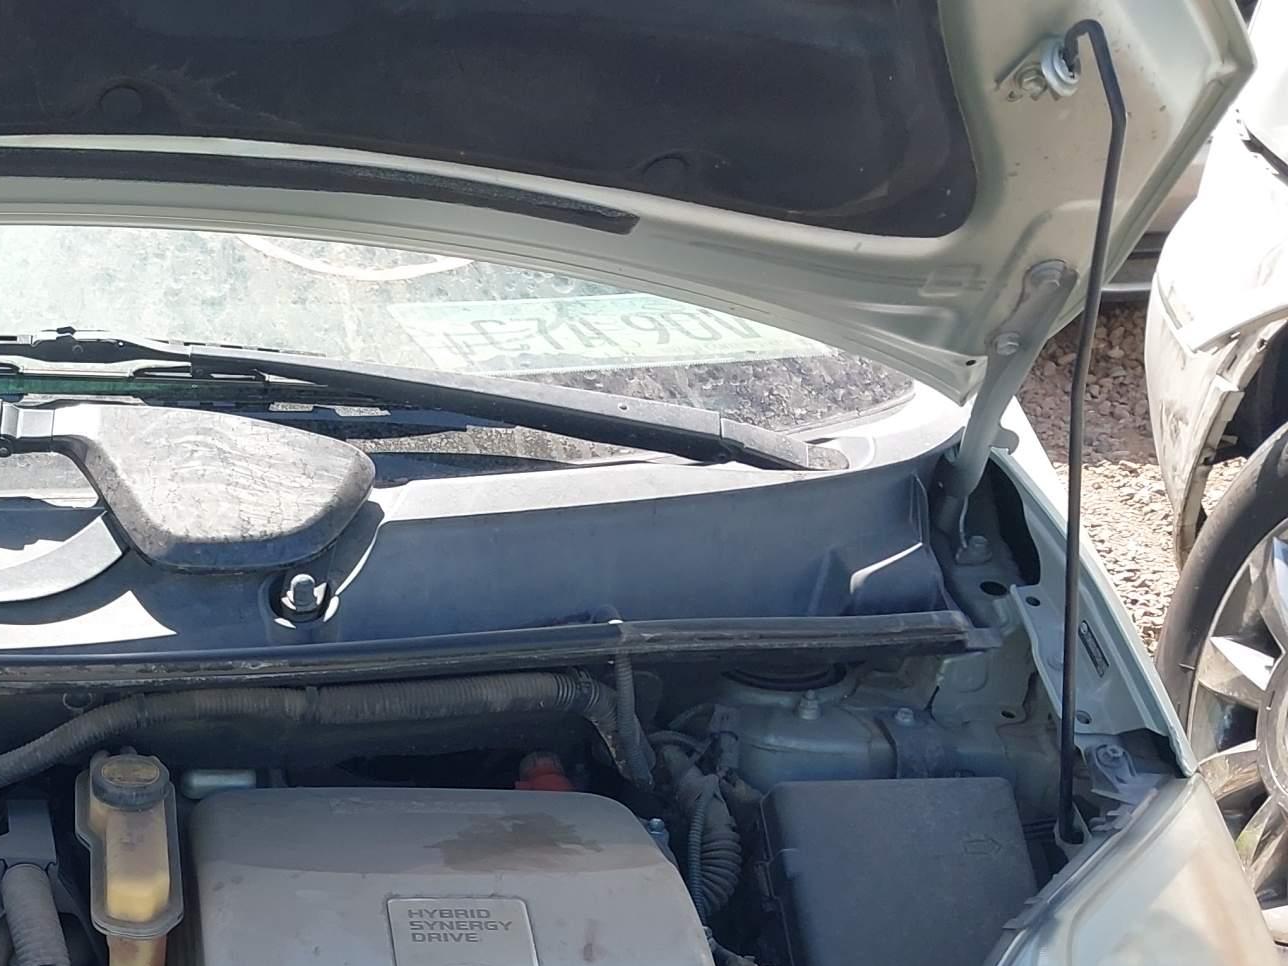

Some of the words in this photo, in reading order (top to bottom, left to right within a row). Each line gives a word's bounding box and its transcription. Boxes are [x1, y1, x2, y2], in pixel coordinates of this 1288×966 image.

[407, 908, 491, 919] HYBRID
[409, 920, 513, 931] SYNERGY
[411, 932, 480, 943] DRIVE
